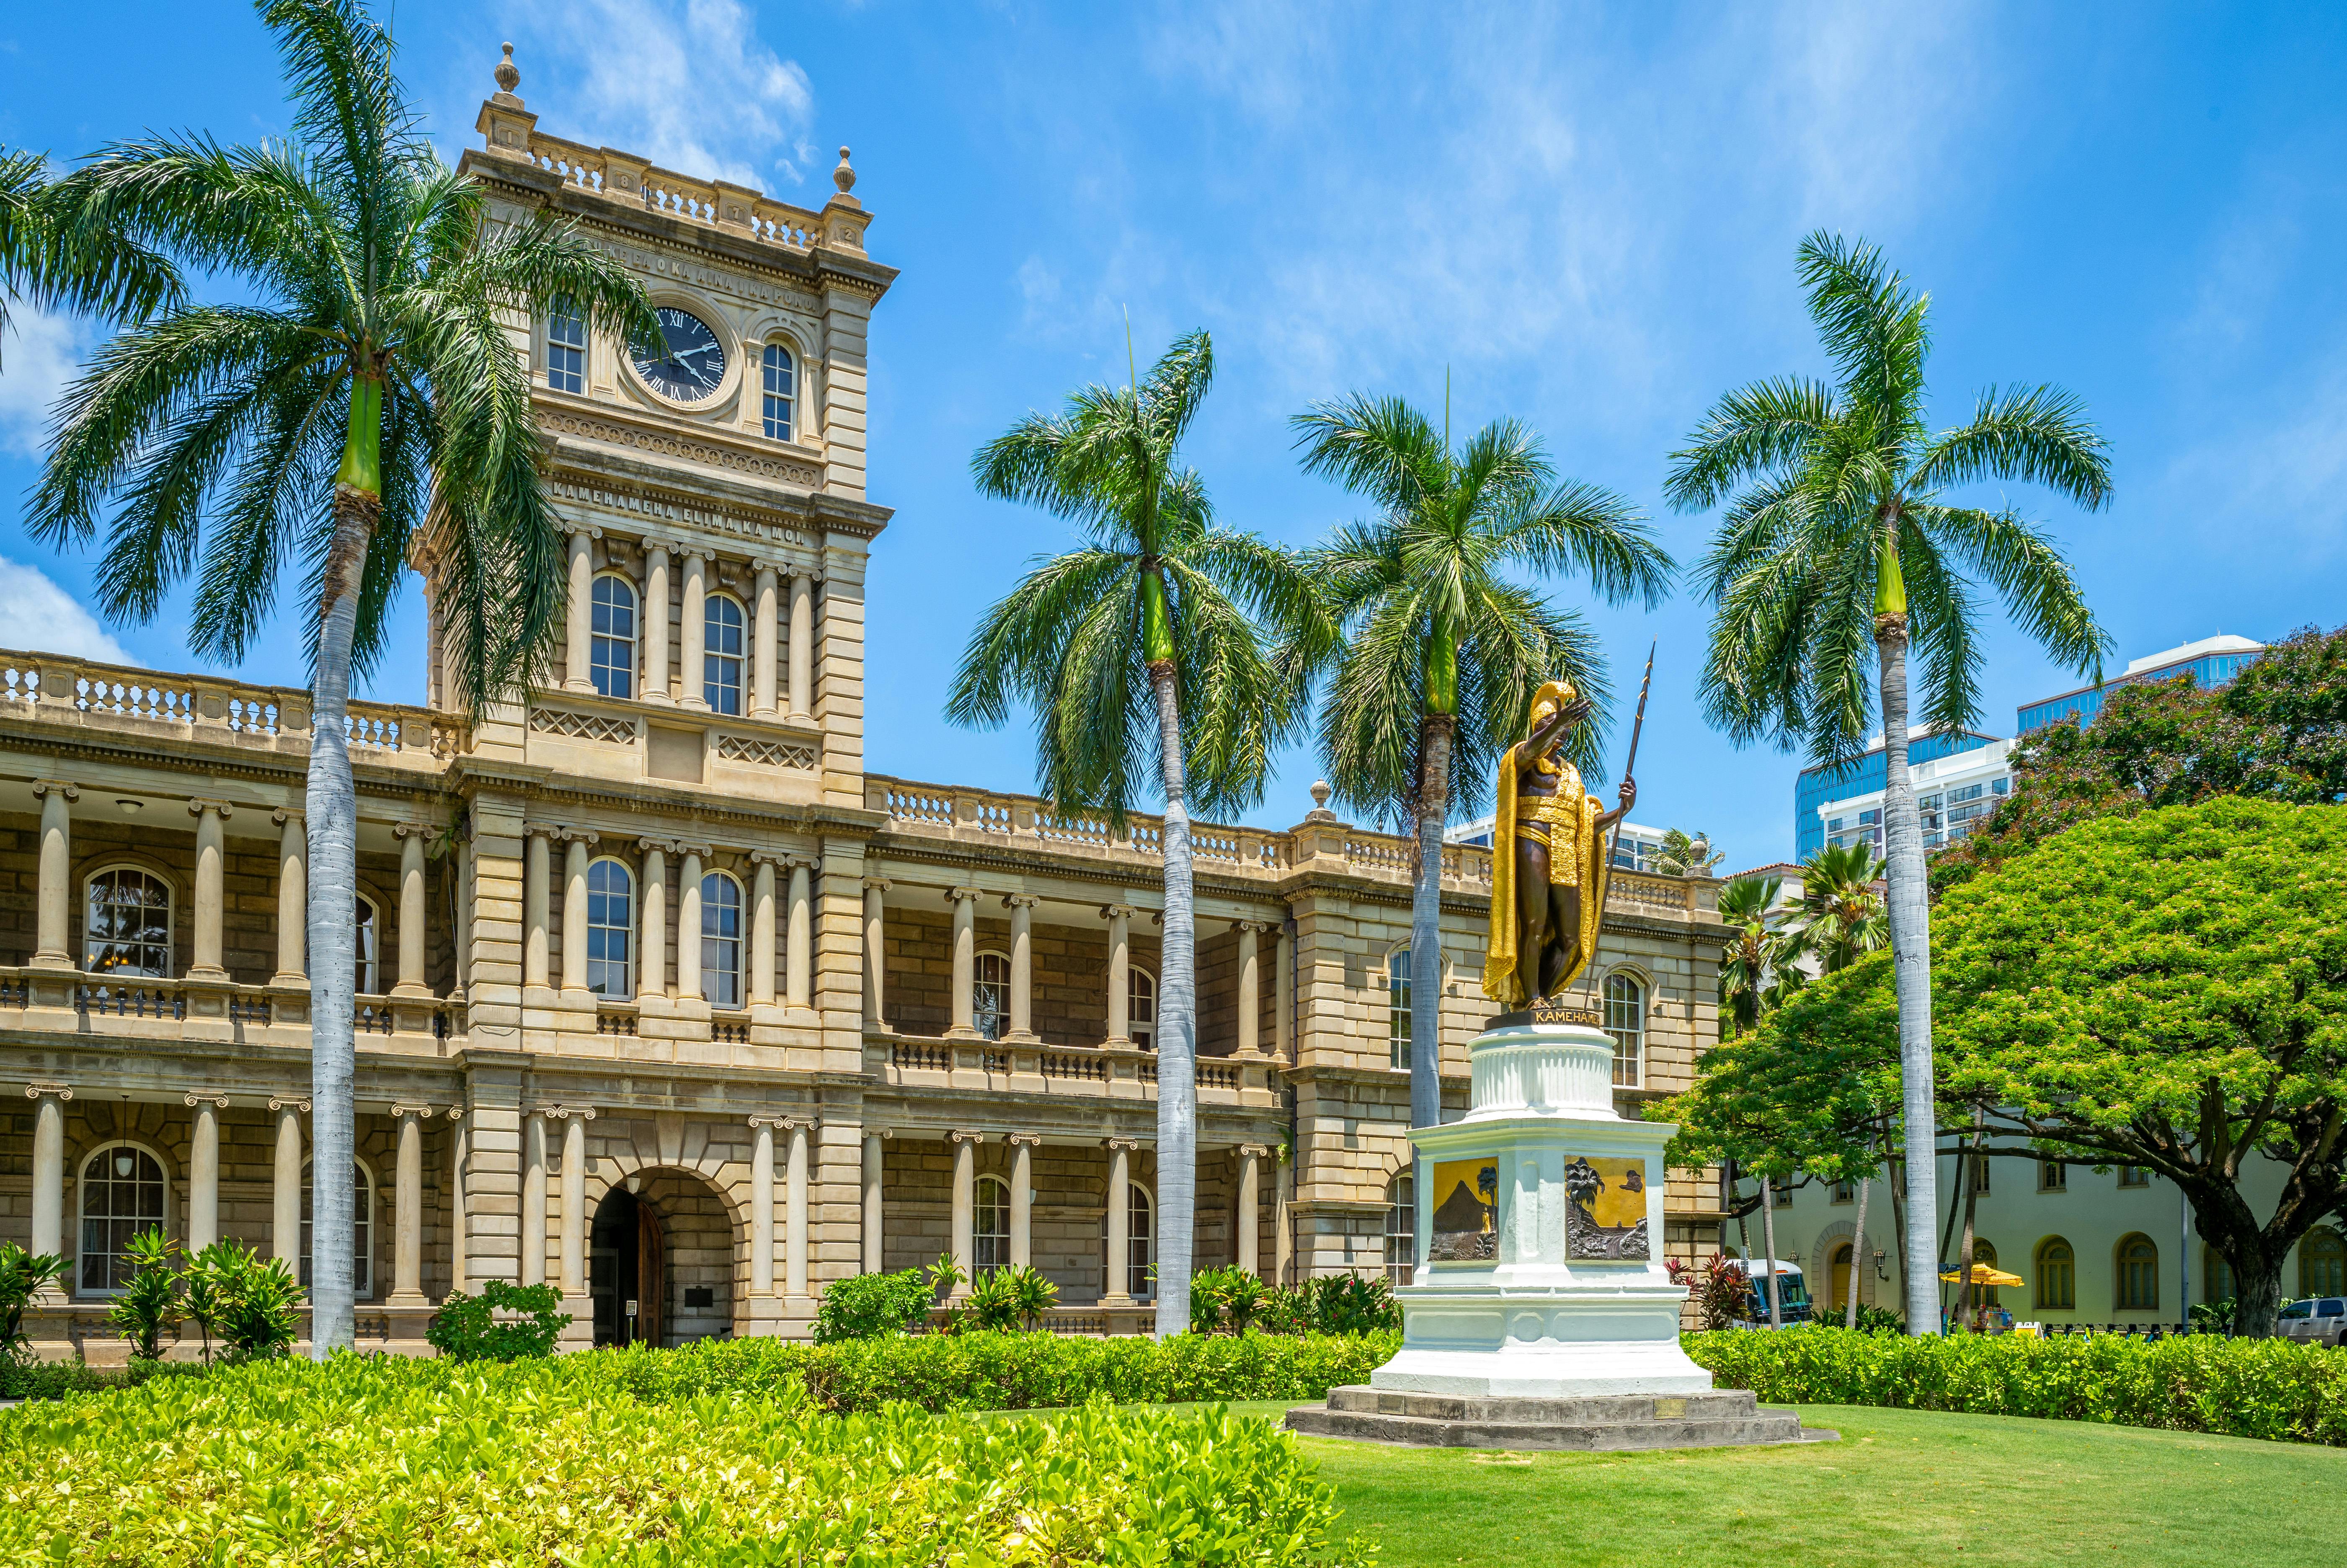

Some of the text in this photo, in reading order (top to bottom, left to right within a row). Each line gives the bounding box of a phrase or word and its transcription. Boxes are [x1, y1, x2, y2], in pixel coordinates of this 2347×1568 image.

[508, 132, 852, 242] 1 8 7 2
[609, 245, 627, 262] KE
[633, 253, 650, 269] EA
[657, 259, 665, 272] O
[672, 261, 690, 279] KA
[738, 280, 743, 293] I
[749, 283, 768, 299] KA
[669, 312, 684, 328] XII
[691, 323, 700, 335] I
[707, 359, 720, 372] III
[690, 386, 702, 400] V
[553, 482, 674, 519] KAMEHAMEHA
[743, 520, 762, 536] KA
